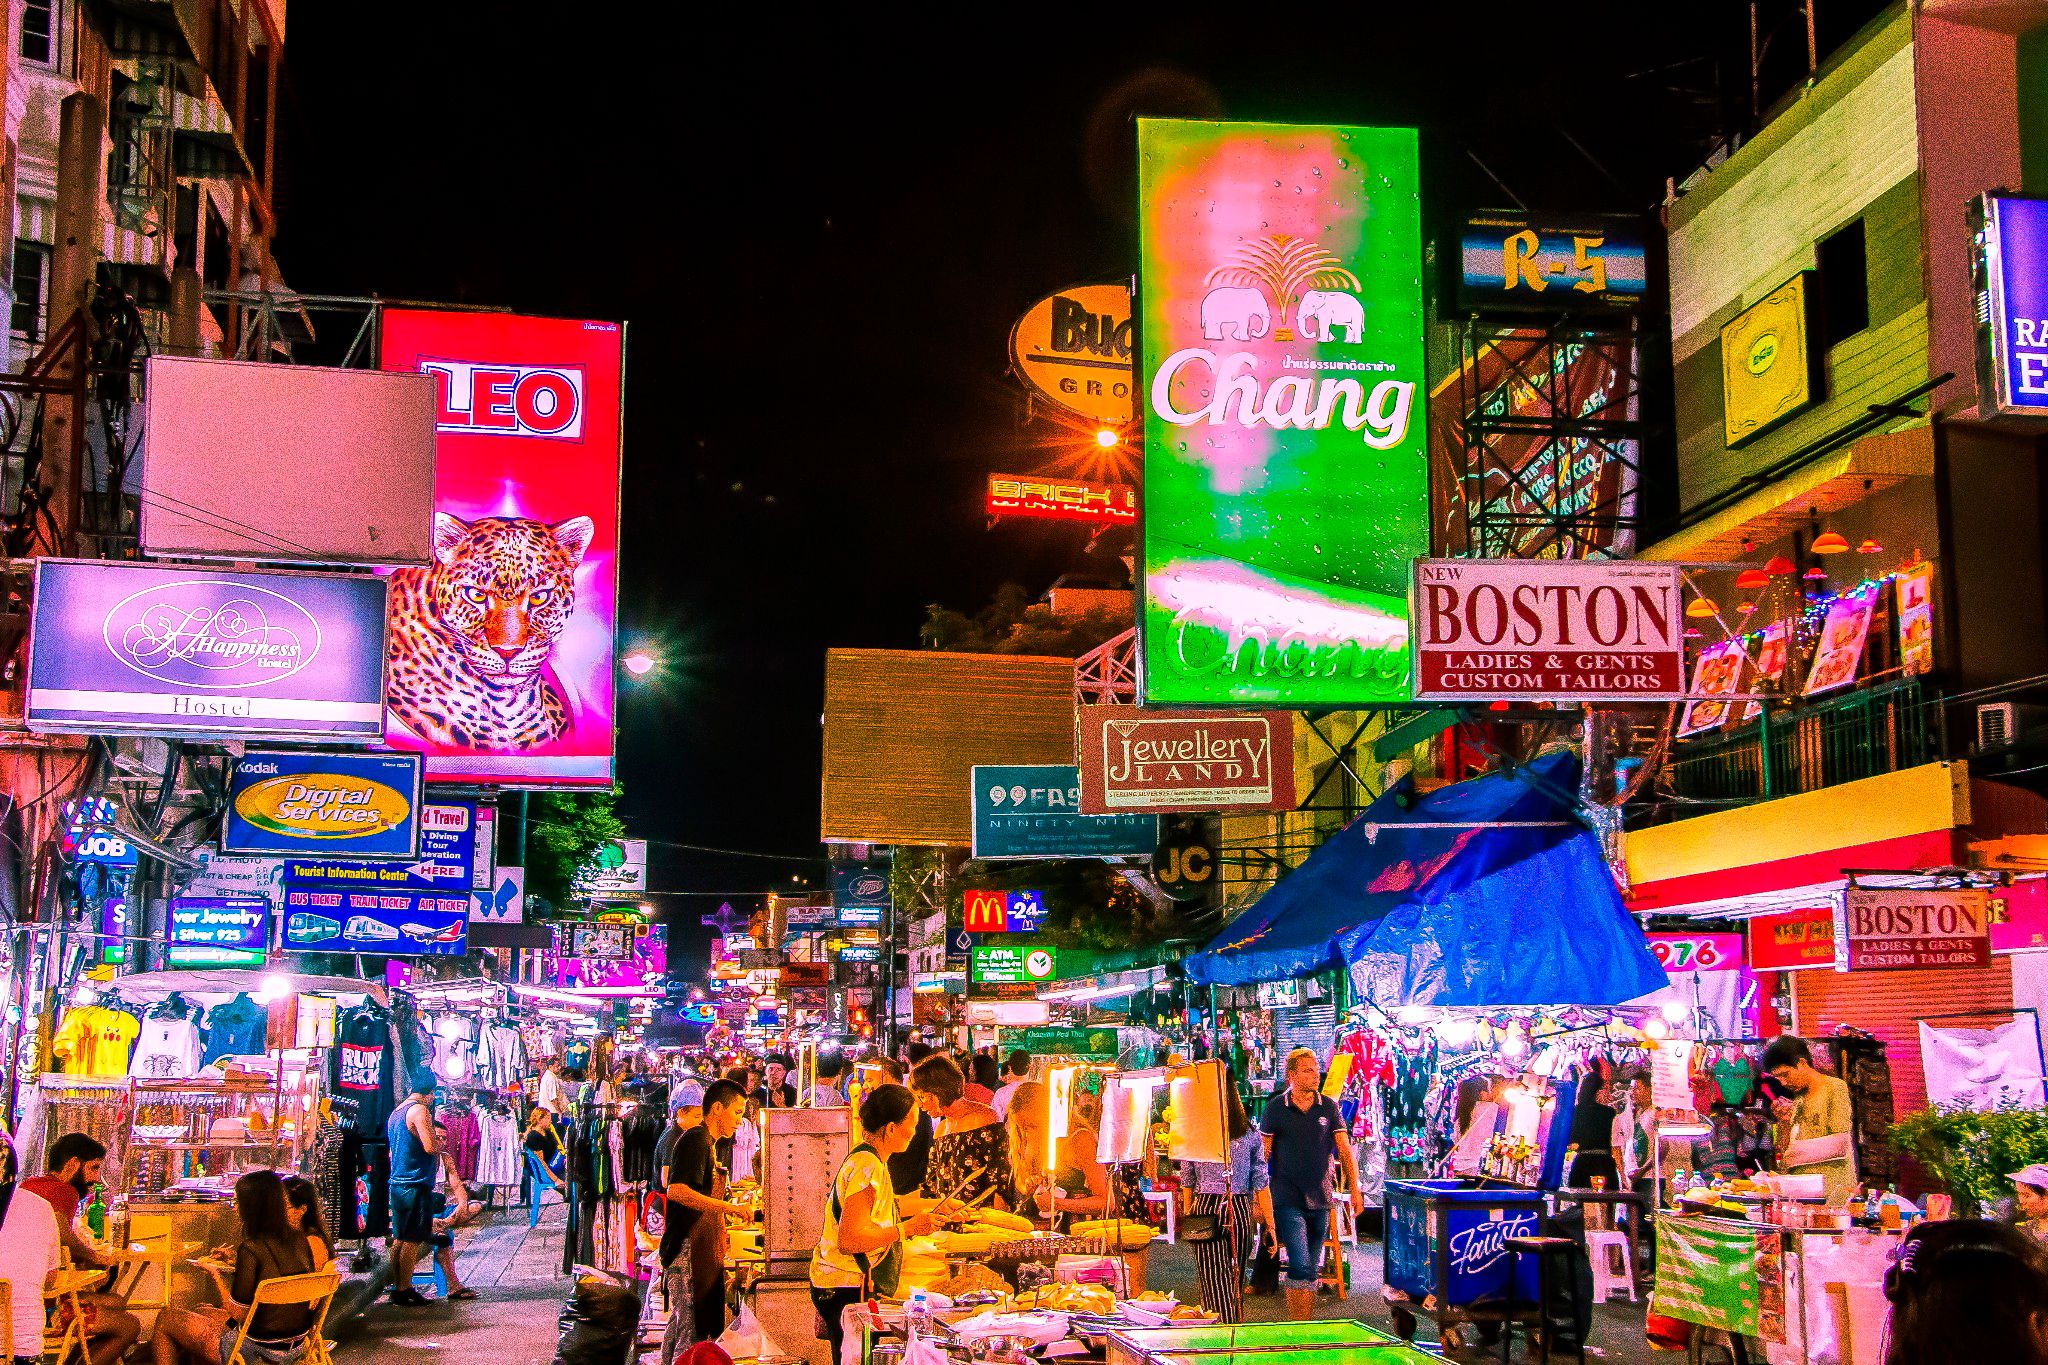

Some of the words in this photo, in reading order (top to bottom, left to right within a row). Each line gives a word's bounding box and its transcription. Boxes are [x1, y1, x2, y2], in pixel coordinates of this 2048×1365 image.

[1503, 229, 1607, 293] R-5
[427, 366, 579, 435] LEO
[1151, 348, 1416, 450] Chang
[992, 481, 1111, 506] BRICK
[1423, 567, 1464, 581] NEW
[1423, 583, 1671, 647] BOSTON
[196, 636, 299, 658] Happiness
[257, 657, 292, 669] Hostel
[1444, 653, 1532, 669] LADIES
[1544, 654, 1563, 669] &
[1575, 654, 1655, 670] GENTS
[1440, 673, 1543, 689] CUSTOM
[1556, 673, 1661, 689] TAILORS
[173, 697, 251, 716] Hostel
[236, 761, 279, 774] Kodak
[1134, 763, 1244, 782] LAND
[285, 784, 374, 808] Digital
[275, 802, 382, 823] Services
[434, 809, 465, 826] Travel
[990, 820, 1076, 828] NINETY
[1096, 817, 1150, 826] NINE
[427, 841, 449, 849] Tour
[429, 832, 459, 843] Diving
[78, 837, 127, 857] JOB
[294, 865, 325, 877] Tourist
[327, 866, 376, 880] Information
[379, 867, 409, 881] Center
[421, 866, 456, 876] HERE
[1159, 846, 1212, 883] JC
[216, 889, 237, 897] GET
[290, 893, 308, 905] BUS
[310, 894, 342, 907] TICKET
[350, 895, 378, 908] TRAIN
[379, 896, 411, 910] TICKET
[418, 898, 435, 910] AIR
[437, 899, 468, 912] TICKET
[1014, 902, 1039, 919] 24
[200, 909, 262, 928] Jewelry
[1854, 904, 1977, 936] BOSTON
[179, 929, 214, 941] Silver
[216, 929, 242, 941] 925
[1861, 940, 1910, 952] LADIES
[1914, 939, 1924, 951] &
[1928, 940, 1973, 951] GENTS
[989, 950, 1014, 960] ATM
[1859, 953, 1915, 965] CUSTOM
[1920, 952, 1977, 964] TAILORS
[342, 1048, 383, 1068] RUN
